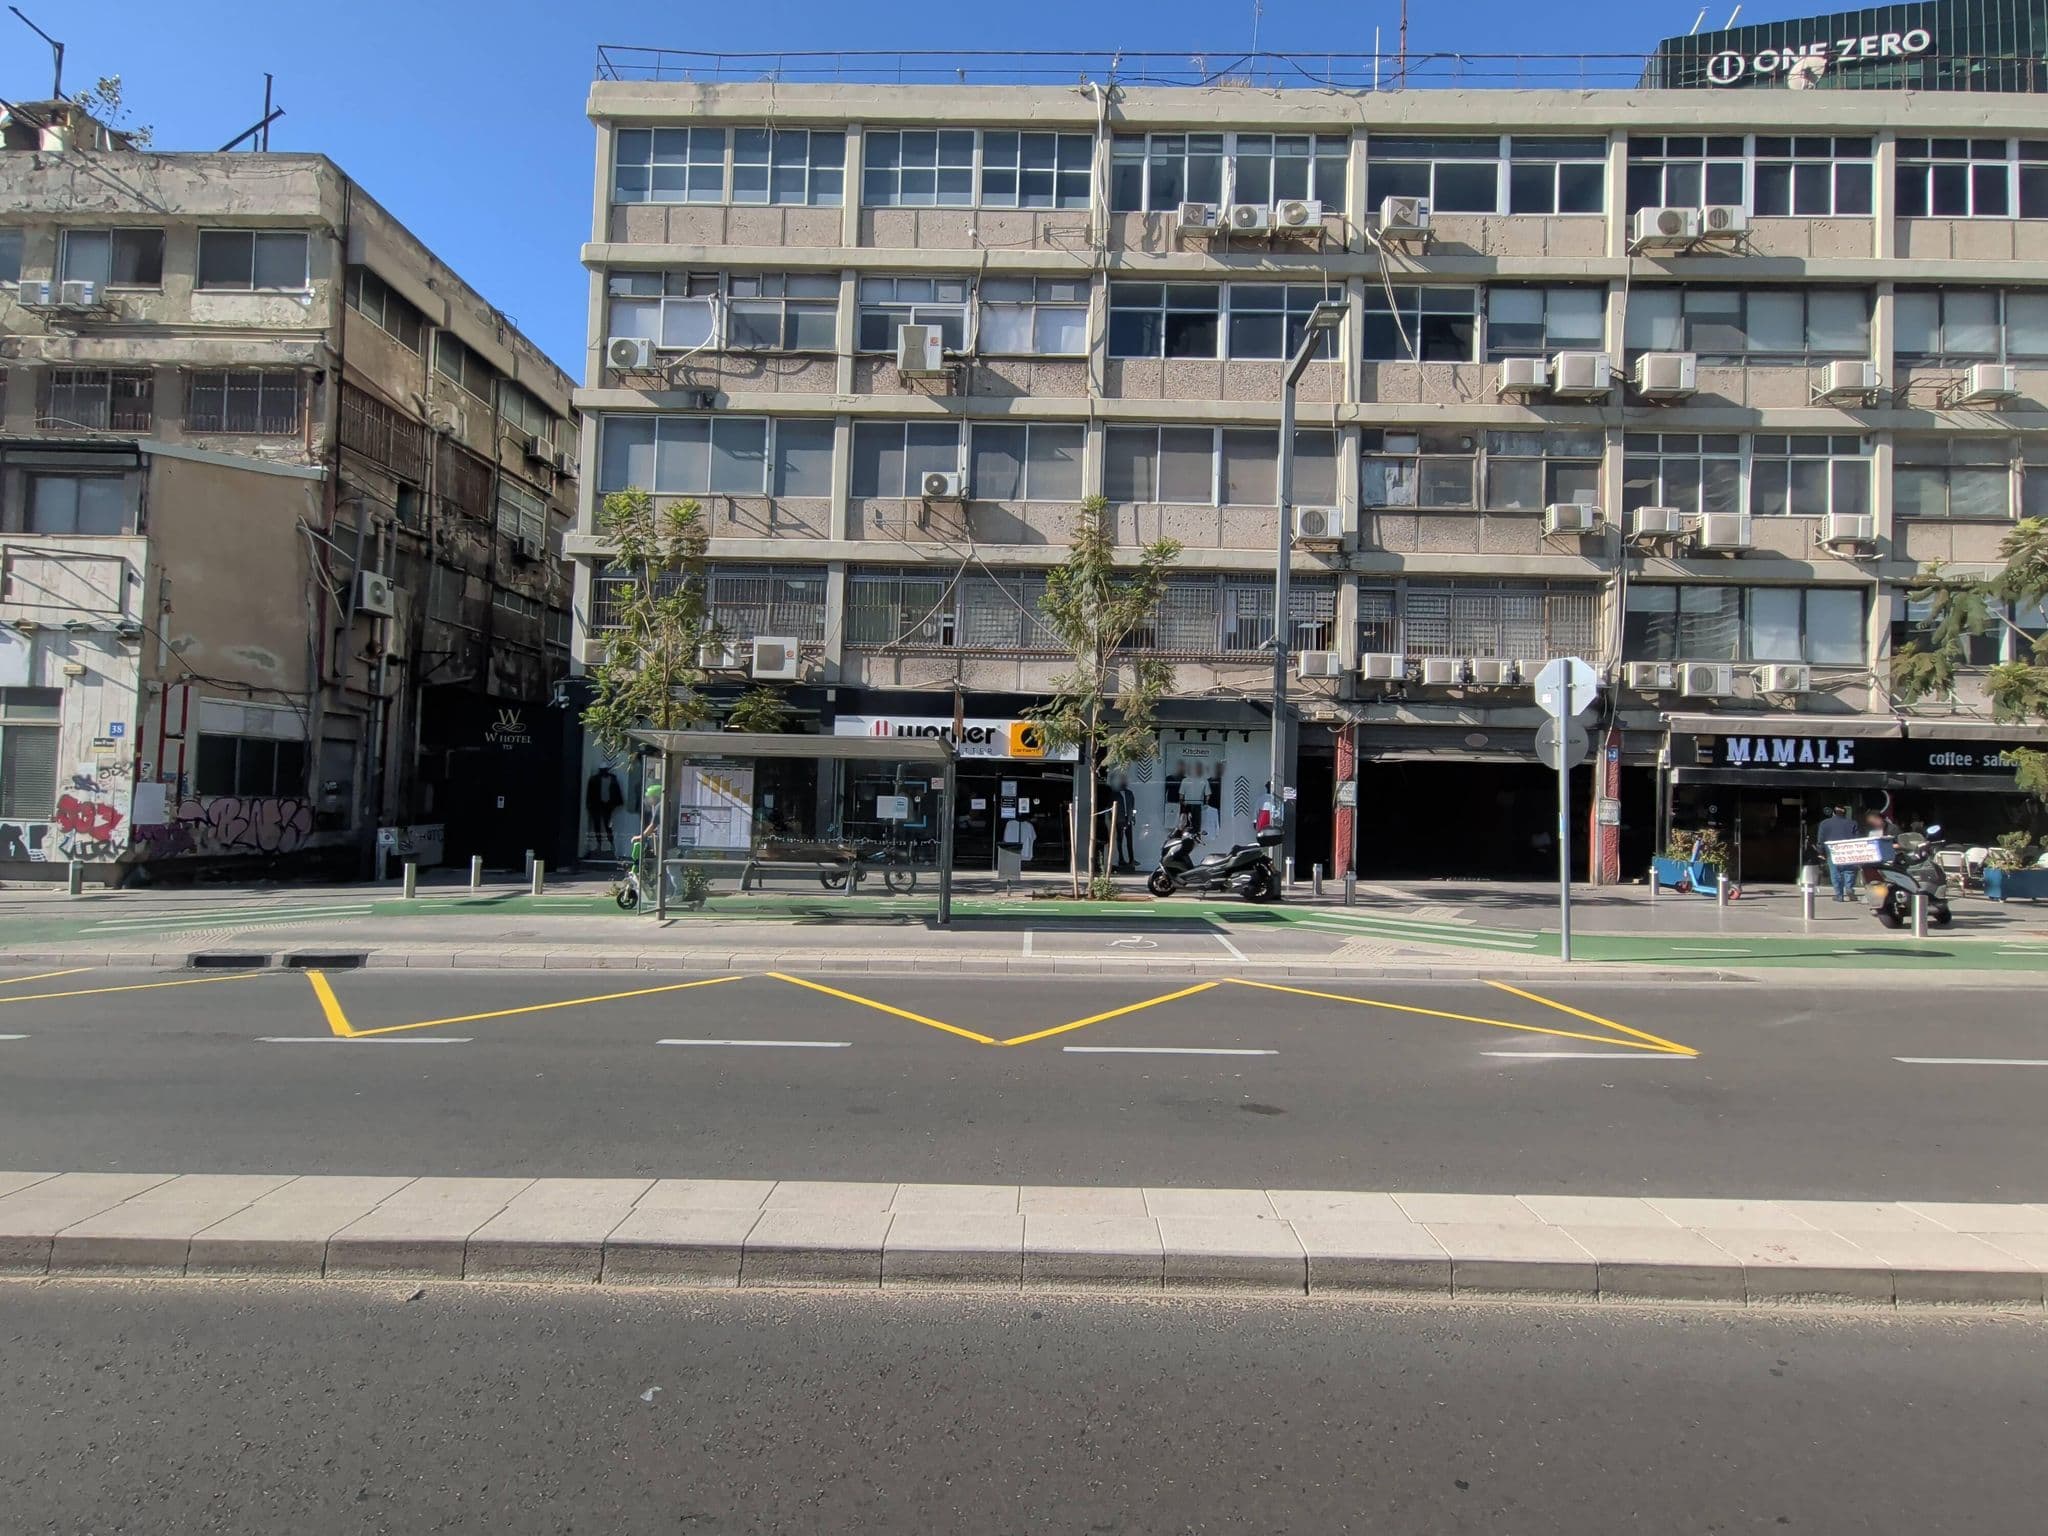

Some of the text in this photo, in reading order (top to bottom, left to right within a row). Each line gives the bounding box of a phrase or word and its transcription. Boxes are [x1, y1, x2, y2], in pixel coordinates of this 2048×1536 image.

[1836, 29, 1931, 62] ZERO
[111, 725, 122, 734] 38
[484, 731, 532, 744] W HOTEL
[1726, 737, 1855, 764] MAMALE
[1929, 751, 1973, 766] coffee
